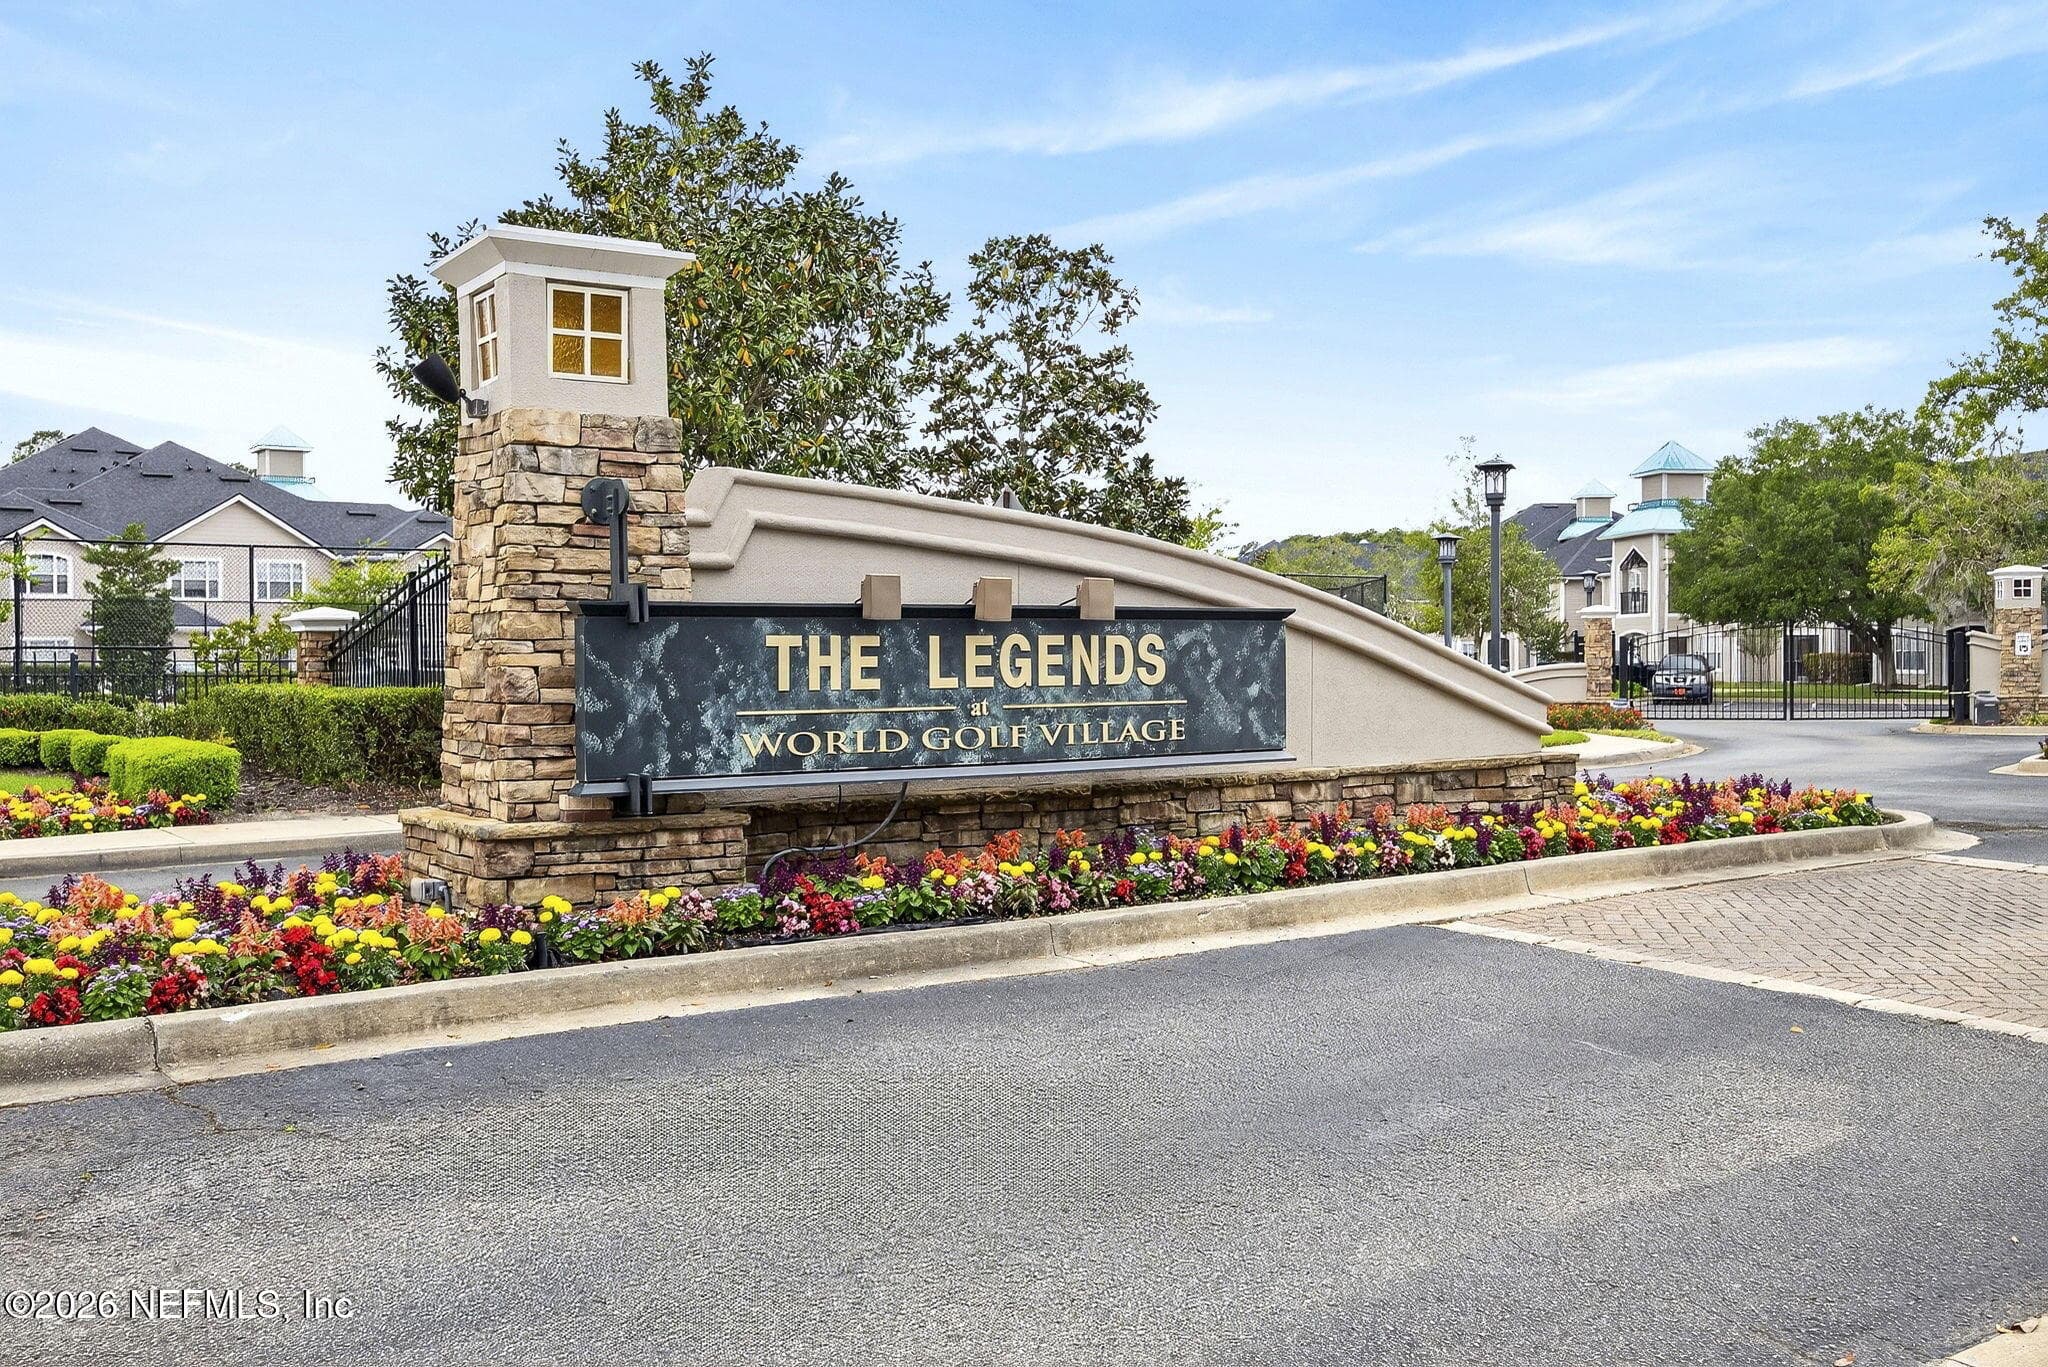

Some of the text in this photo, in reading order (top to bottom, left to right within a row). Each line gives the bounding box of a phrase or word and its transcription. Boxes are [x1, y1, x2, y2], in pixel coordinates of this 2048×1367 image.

[764, 634, 1166, 692] THE LEGENDS
[971, 700, 988, 717] at
[739, 719, 1186, 758] WORLD GOLF VILLAGE
